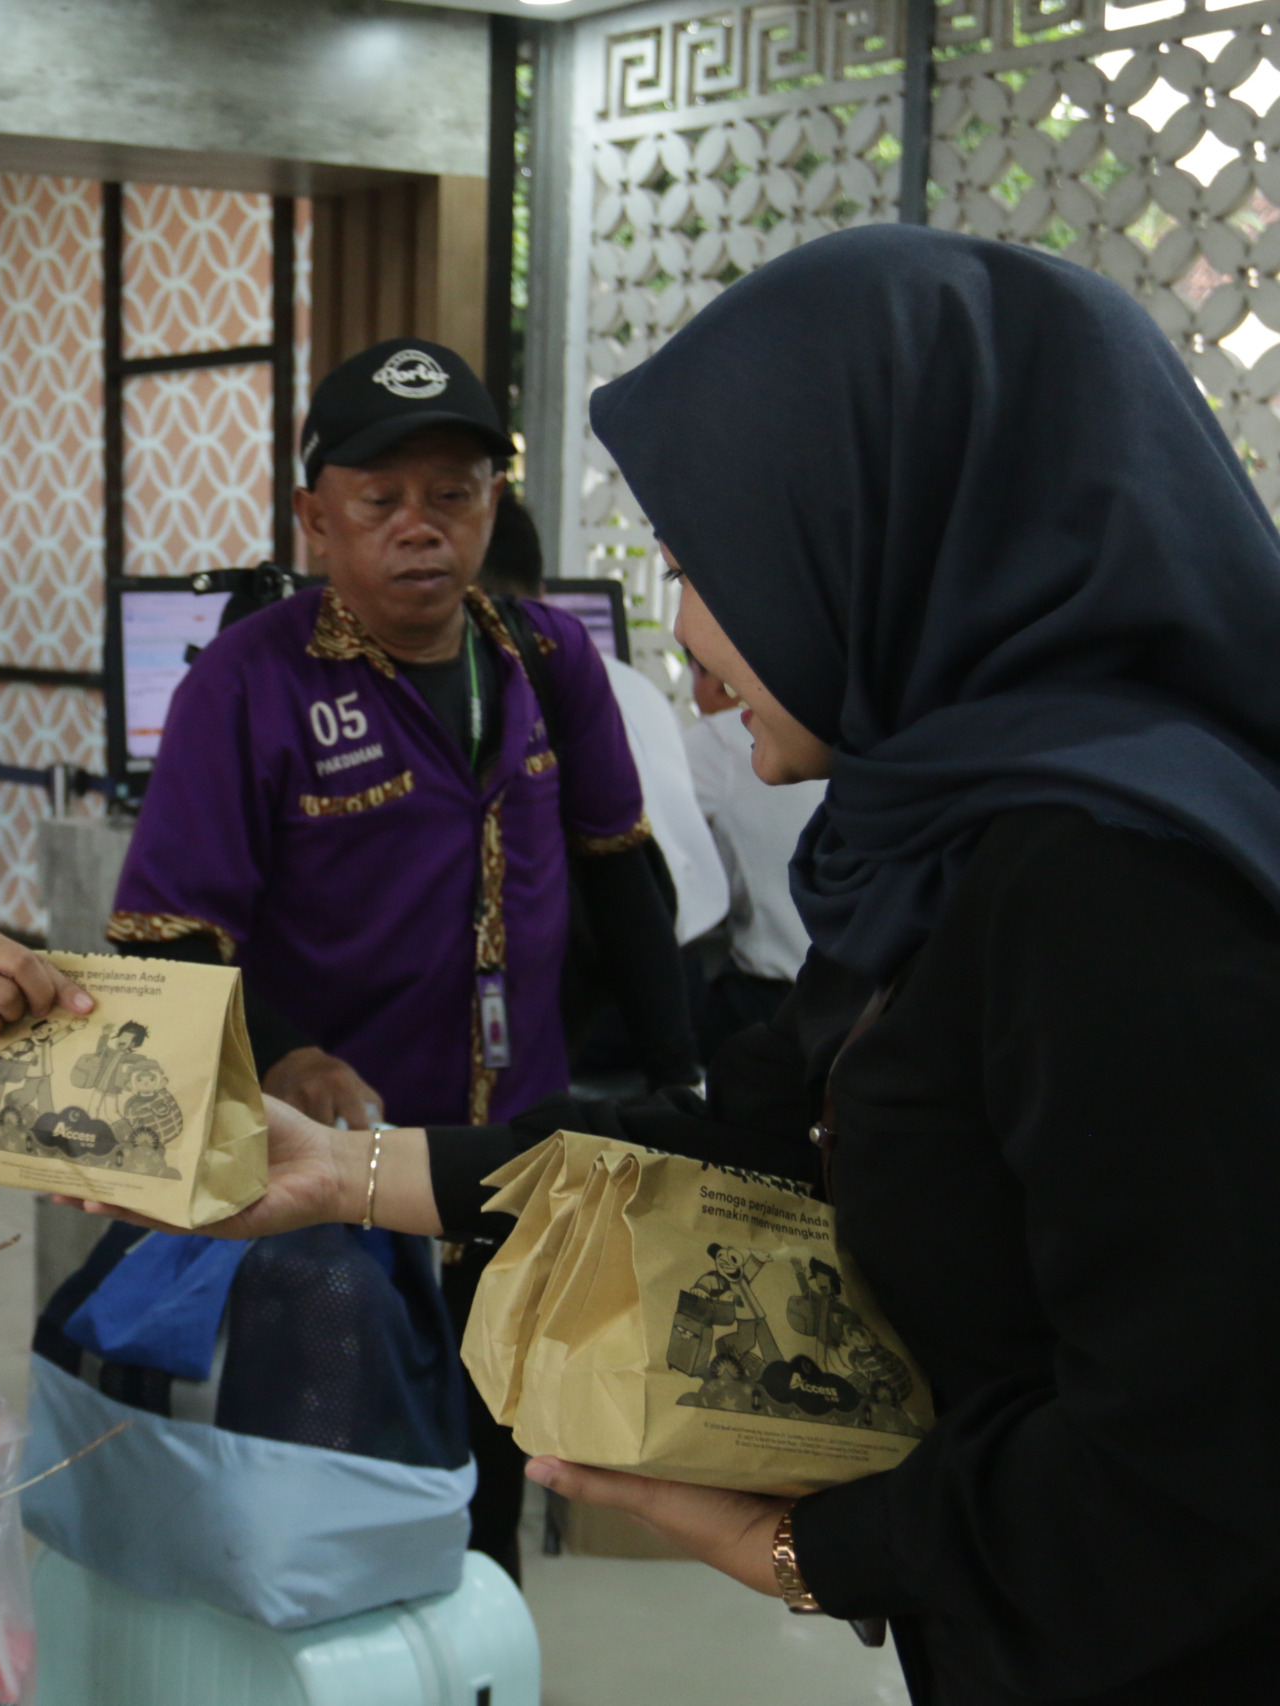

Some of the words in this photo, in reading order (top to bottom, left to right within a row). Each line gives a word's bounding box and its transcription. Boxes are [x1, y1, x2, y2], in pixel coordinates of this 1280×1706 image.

[310, 690, 368, 746] 05
[87, 969, 137, 981] perjalanan
[140, 972, 166, 983] Anda
[89, 983, 162, 997] menyenangkan
[52, 1121, 96, 1143] Access
[700, 1185, 747, 1208] Semoga
[749, 1200, 797, 1221] perjalanan
[800, 1212, 829, 1228] Anda
[701, 1204, 749, 1223] semakin
[751, 1216, 830, 1241] menyenangkan
[789, 1372, 838, 1396] Access
